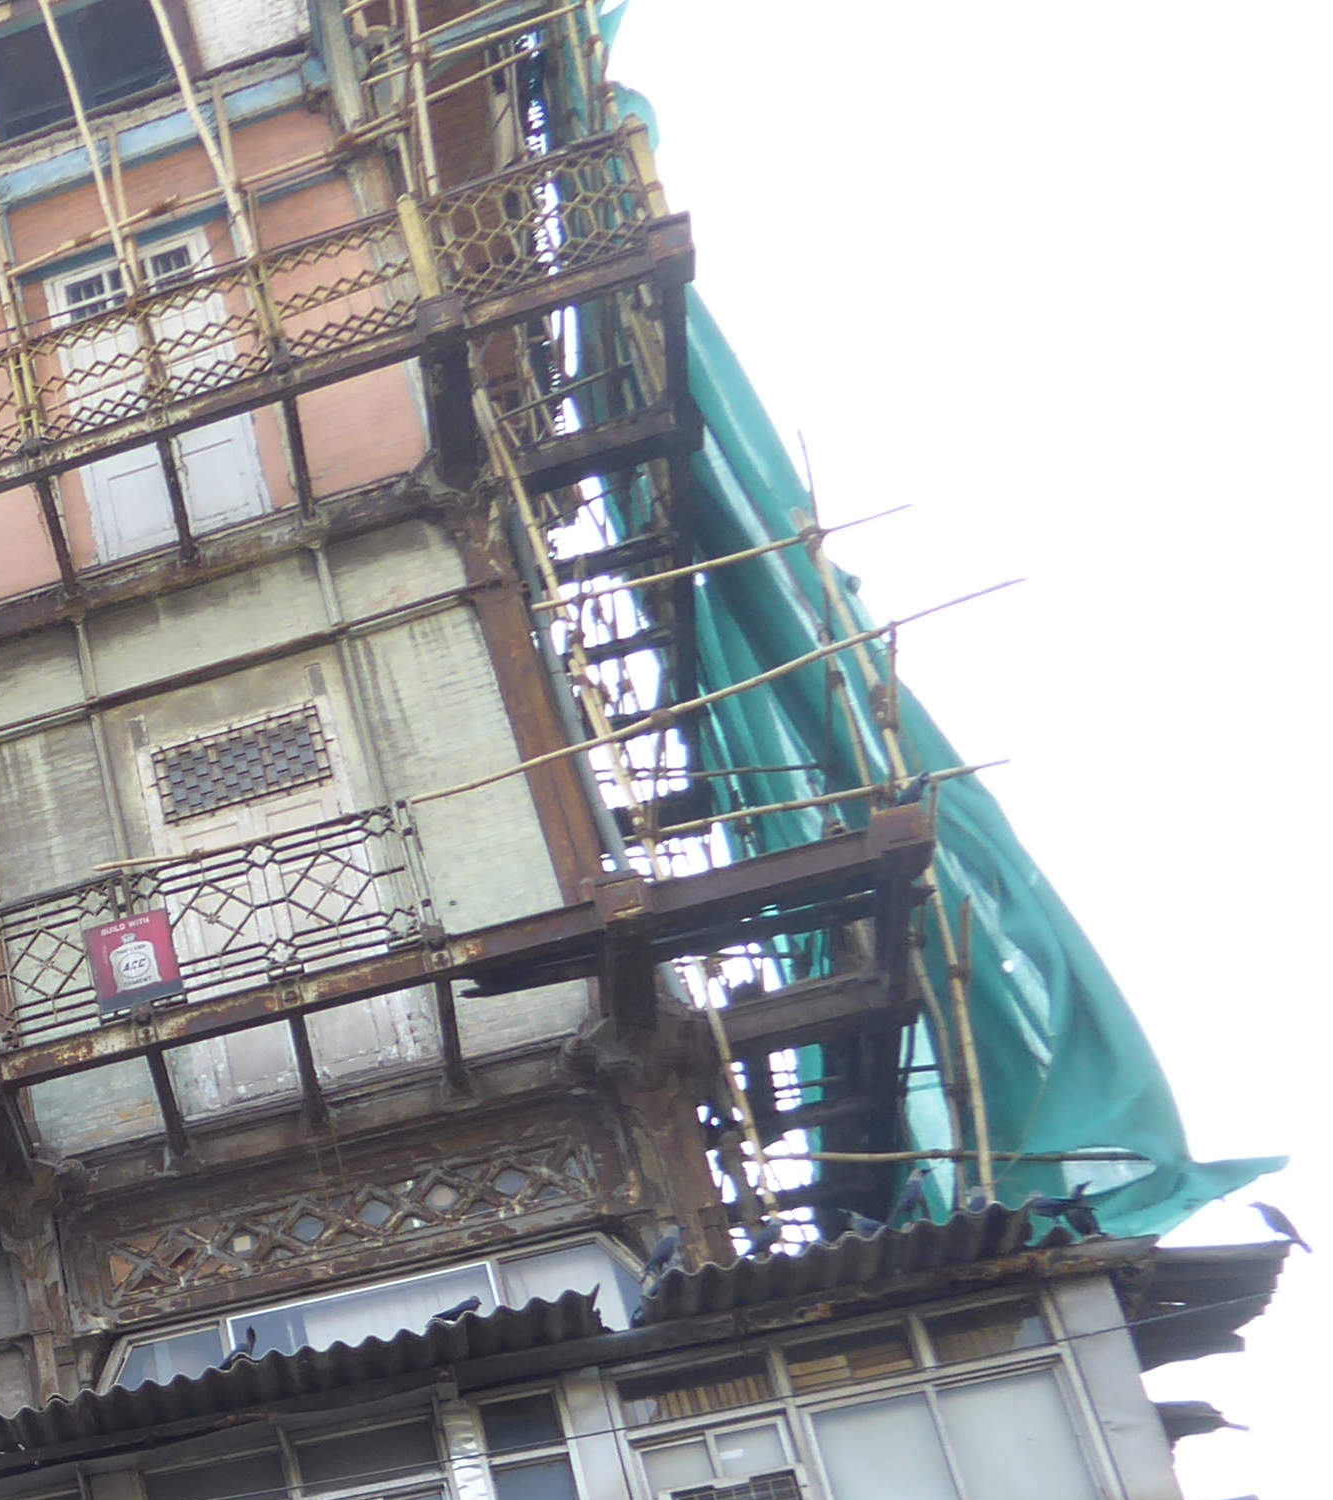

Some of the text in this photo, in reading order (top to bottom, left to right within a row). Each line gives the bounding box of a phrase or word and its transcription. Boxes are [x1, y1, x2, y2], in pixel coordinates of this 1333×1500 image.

[101, 917, 151, 937] BUILD WITH
[123, 957, 147, 973] ACC
[123, 975, 152, 987] CEMENT
